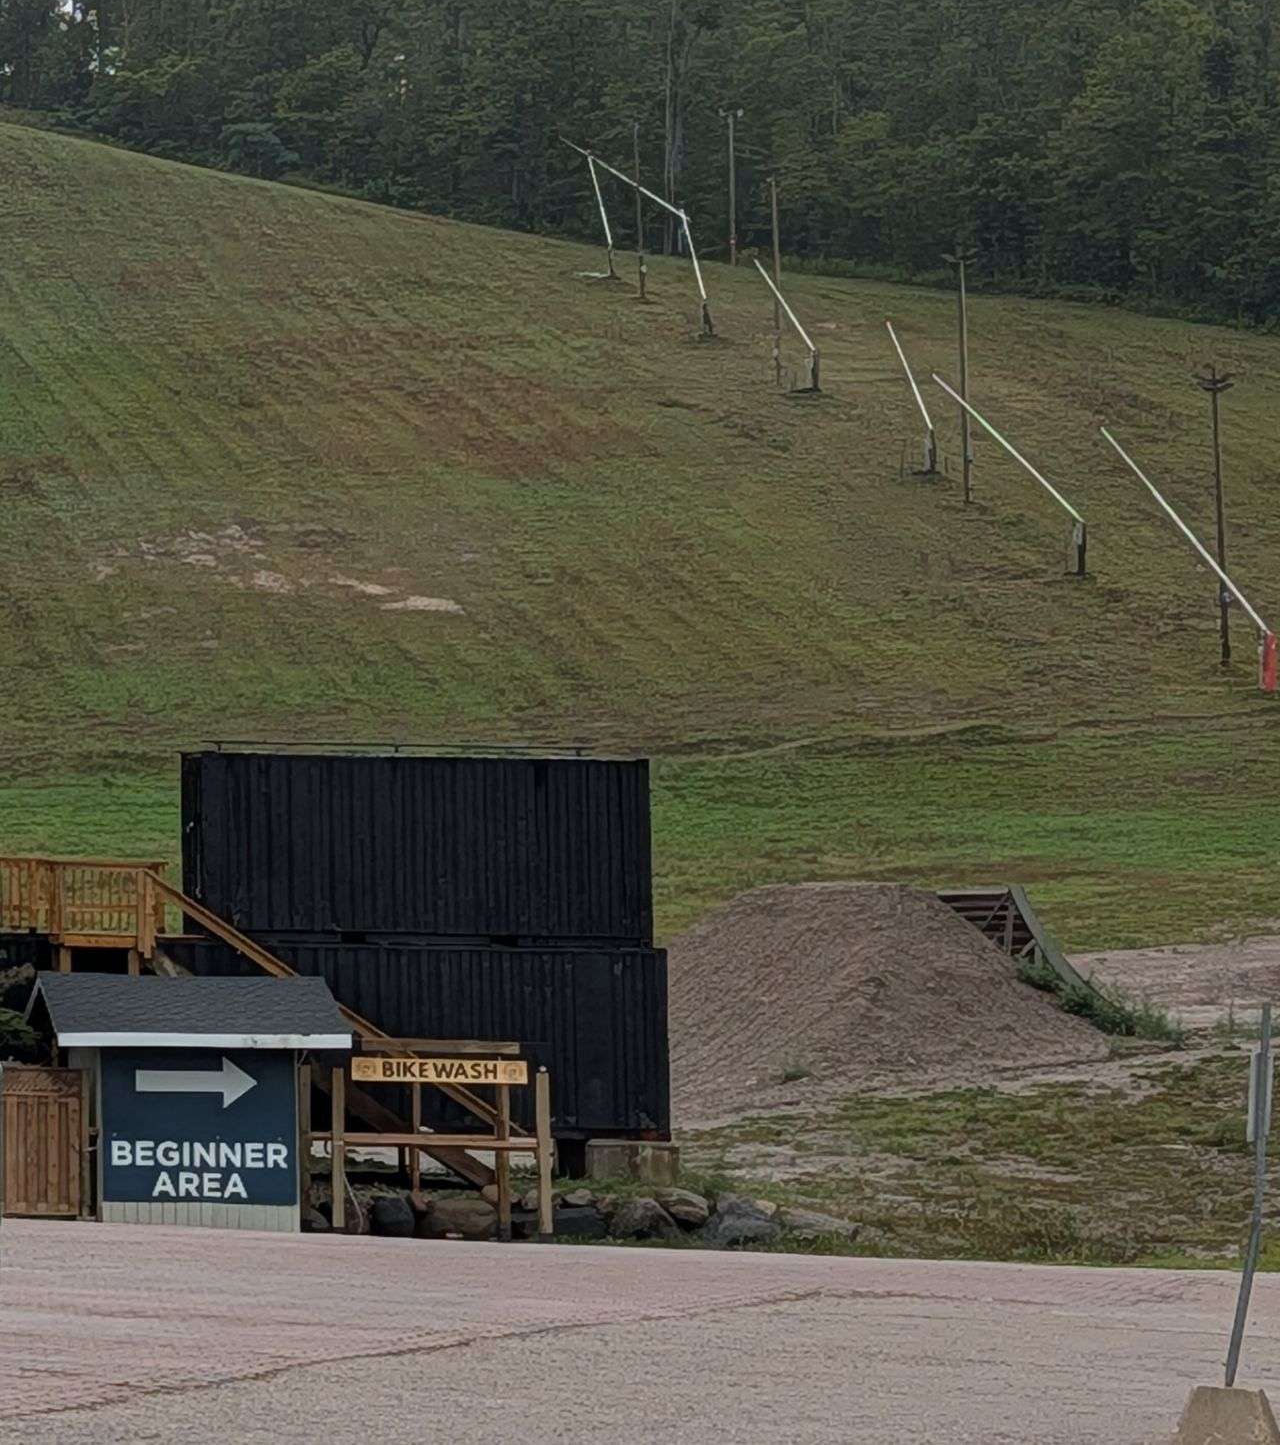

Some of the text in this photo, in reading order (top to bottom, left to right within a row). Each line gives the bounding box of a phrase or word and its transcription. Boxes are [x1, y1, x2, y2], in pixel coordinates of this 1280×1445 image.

[382, 1061, 498, 1080] BIKE WASH
[111, 1140, 288, 1169] BEGINNER
[152, 1171, 248, 1199] AREA
